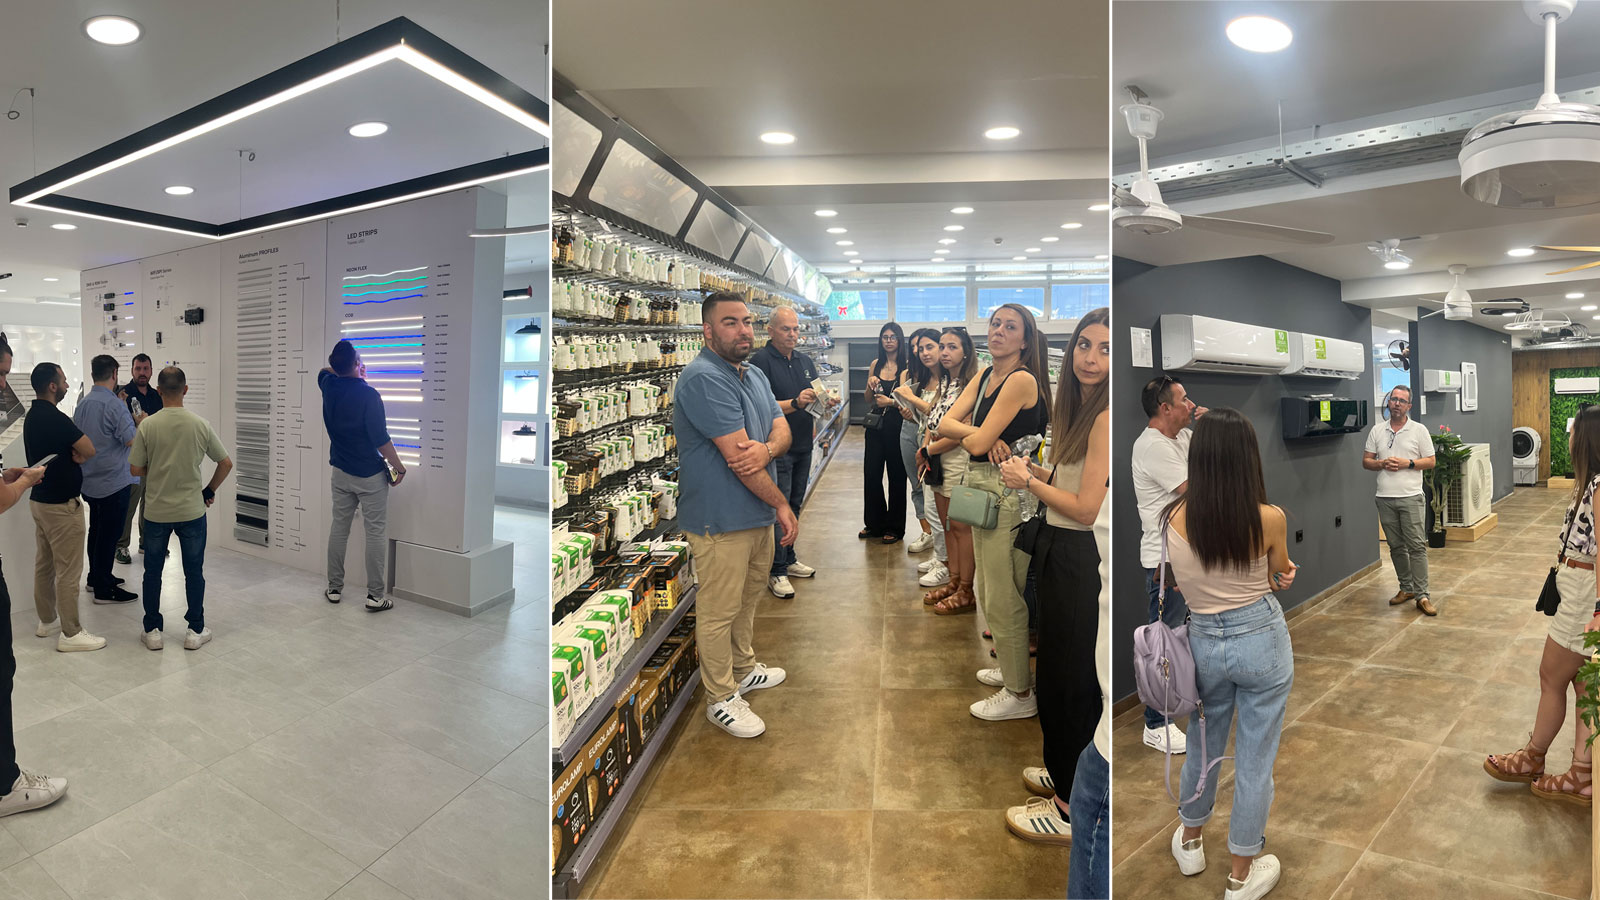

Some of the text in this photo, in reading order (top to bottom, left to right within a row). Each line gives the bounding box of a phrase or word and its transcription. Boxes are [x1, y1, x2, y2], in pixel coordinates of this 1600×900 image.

[347, 229, 378, 240] LED STRIPS
[259, 247, 279, 256] PROFILES
[588, 720, 617, 759] EUROLAMP
